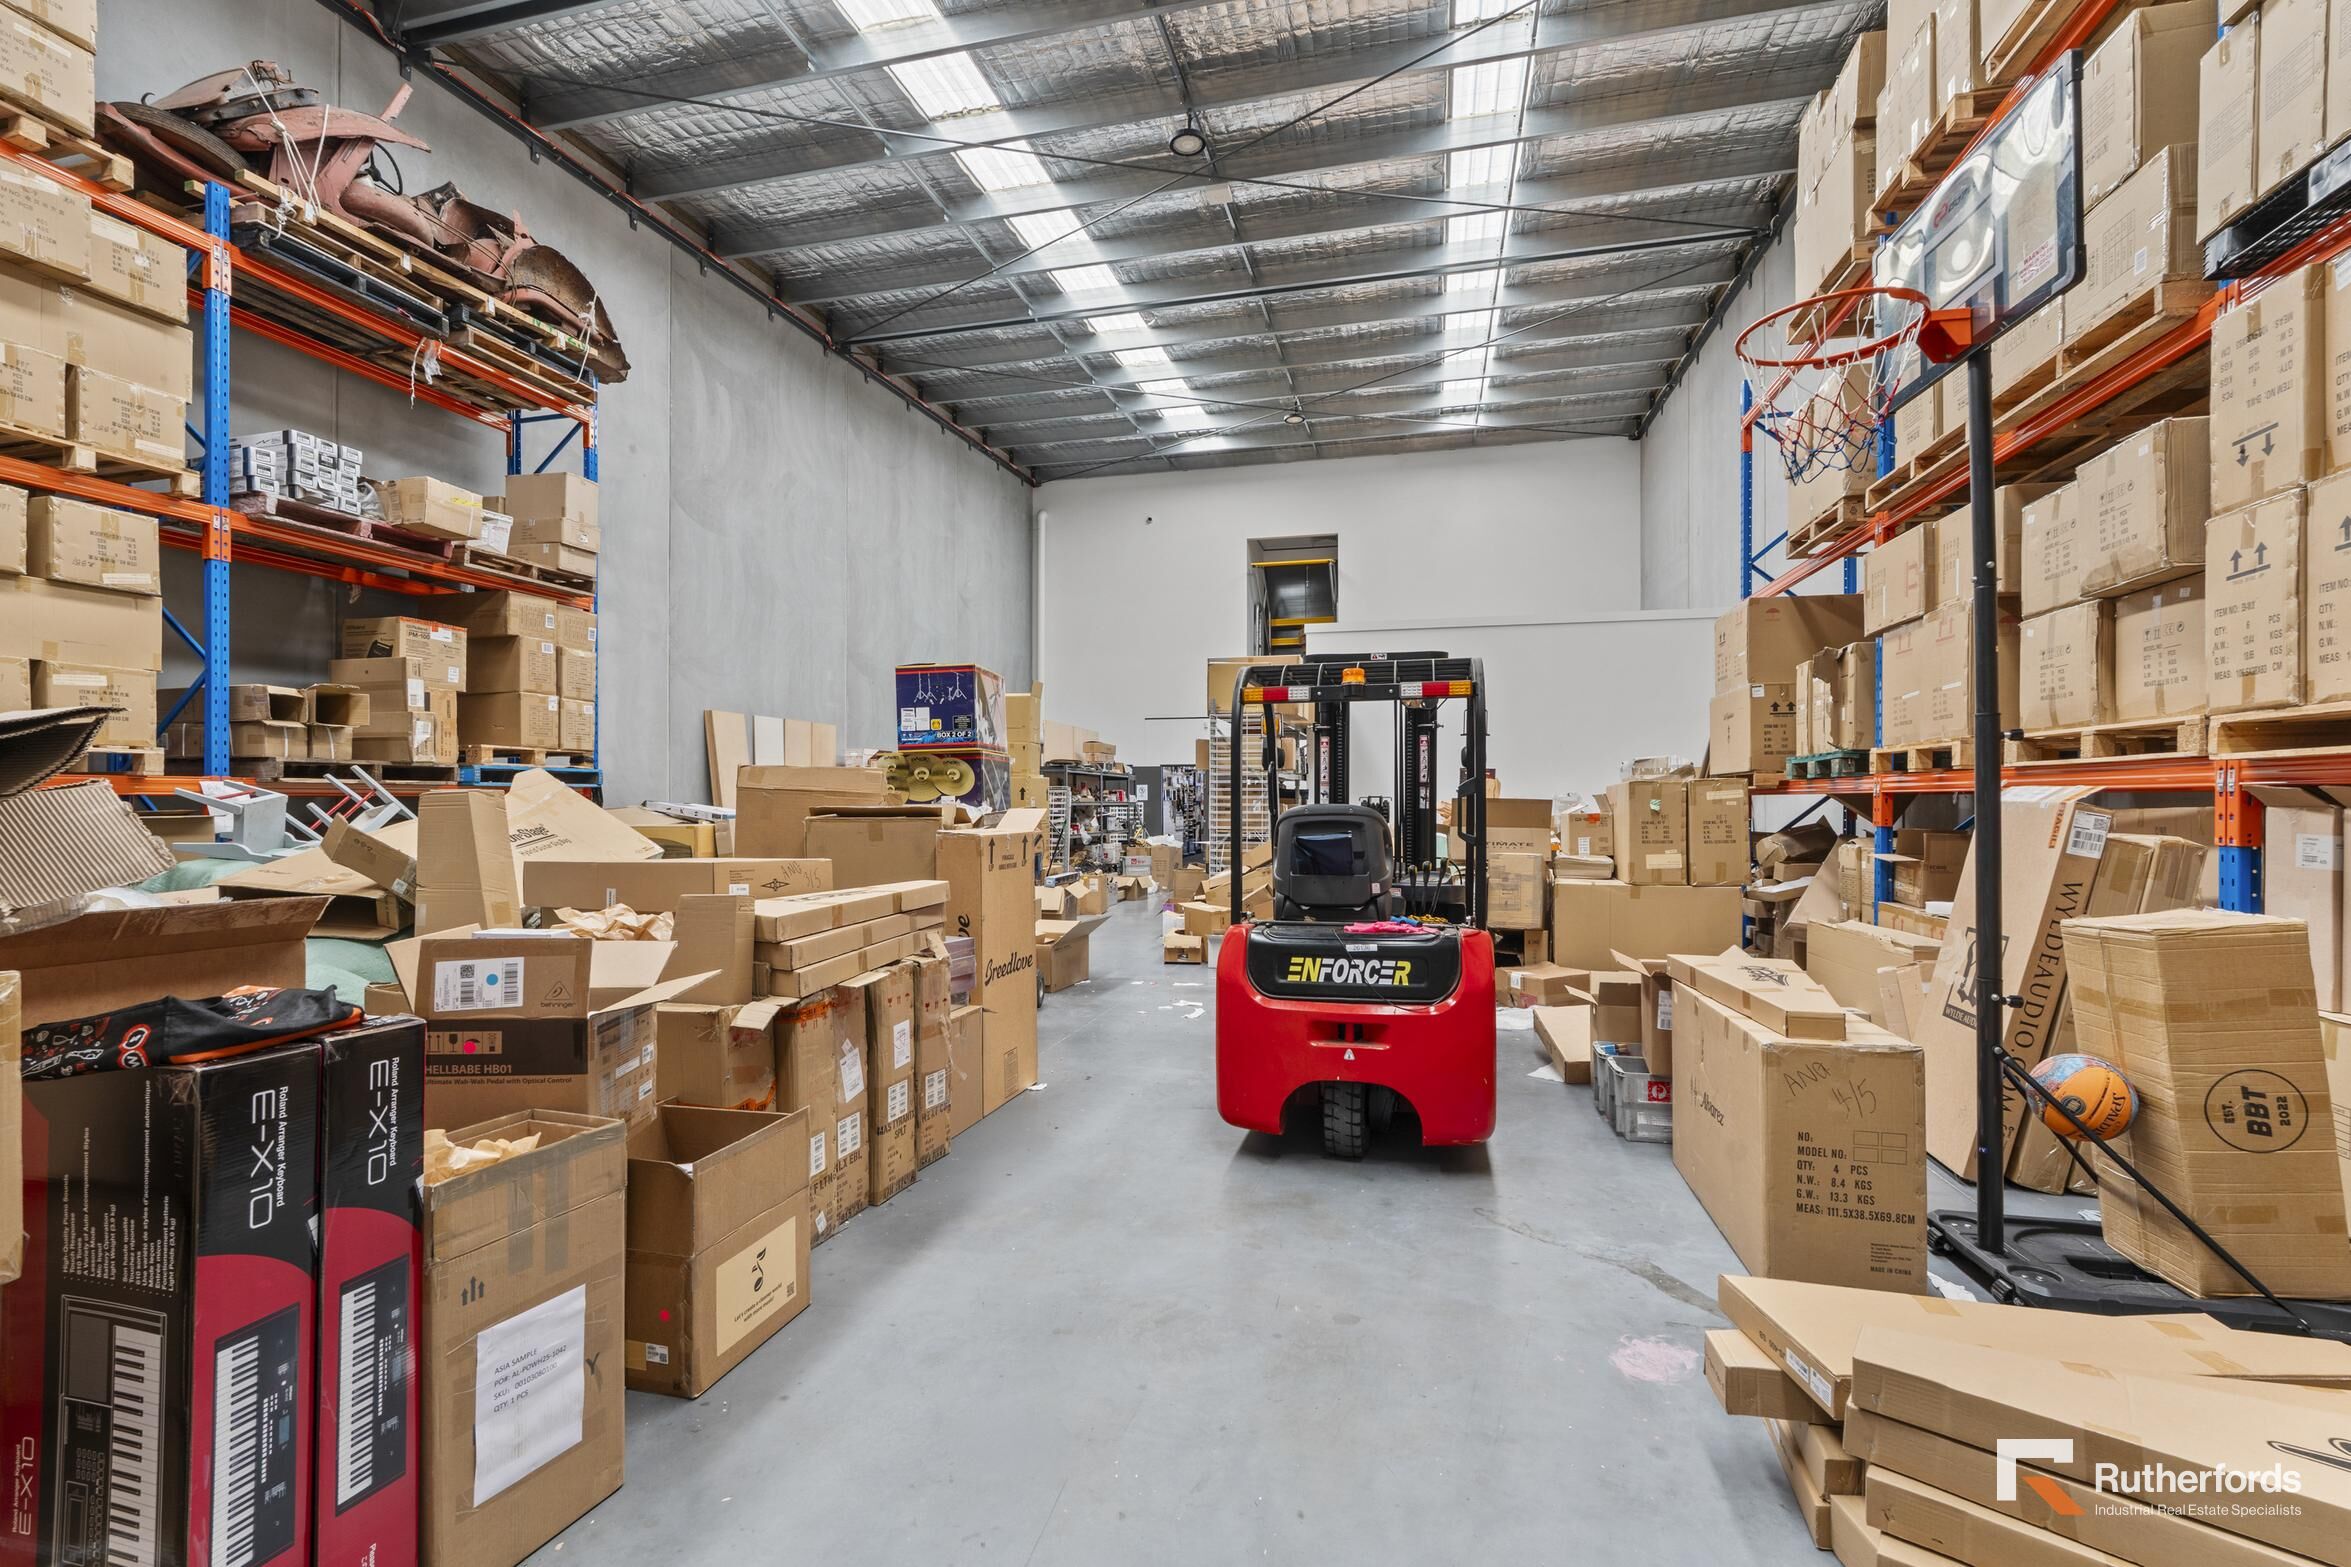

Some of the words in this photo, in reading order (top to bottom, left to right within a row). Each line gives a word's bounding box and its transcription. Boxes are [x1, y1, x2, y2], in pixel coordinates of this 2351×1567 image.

[2024, 241, 2049, 266] WARNING
[2319, 582, 2336, 593] ITEM
[2214, 607, 2227, 618] ITEM
[2319, 603, 2336, 614] QTY:
[2268, 614, 2281, 624] PCS
[2270, 629, 2283, 640] KGS
[2270, 645, 2283, 656] KGS
[2319, 652, 2341, 664] MEAS:
[2214, 670, 2232, 681] MEAS:
[2272, 662, 2283, 671] CM
[985, 952, 1033, 986] Breedlove
[1288, 957, 1412, 986] ENFORCER
[540, 1001, 574, 1009] behringer
[1945, 1007, 1964, 1020] WYLDE
[391, 1057, 399, 1086] Roland
[426, 1065, 480, 1075] HELLBABE
[484, 1065, 512, 1074] HB01
[522, 1077, 546, 1085] Optical
[279, 1086, 288, 1118] Roland
[389, 1088, 399, 1125] Arranger
[1700, 1092, 1724, 1126] Alvarez
[2241, 1085, 2273, 1137] BBT
[2276, 1096, 2291, 1126] 2022
[2222, 1100, 2235, 1124] EST.
[367, 1060, 389, 1186] E-X10
[276, 1122, 288, 1160] Arranger
[389, 1126, 398, 1166] Keyboard
[1798, 1132, 1813, 1143] NO:
[250, 1090, 275, 1229] E-X10
[1797, 1146, 1827, 1158] MODEL
[1831, 1150, 1847, 1159] NO:
[1797, 1160, 1815, 1171] QTY:
[1834, 1165, 1839, 1174] 4
[1850, 1165, 1868, 1176] PCS
[276, 1162, 288, 1207] Keyboard
[1797, 1175, 1820, 1186] N.W.:
[1831, 1178, 1845, 1188] 8.4
[1854, 1180, 1872, 1190] KGS
[1796, 1189, 1819, 1200] G.W.:
[1830, 1192, 1848, 1203] 13.3
[1857, 1194, 1875, 1205] KGS
[1796, 1203, 1824, 1215] MEAS:
[1827, 1207, 1916, 1224] 111.5X38.5X69.8CM
[1895, 1268, 1912, 1276] CHINA
[494, 1362, 510, 1375] ASIA
[511, 1348, 537, 1367] SAMPLE
[516, 1389, 529, 1403] PCS
[19, 1436, 34, 1535] E-X10
